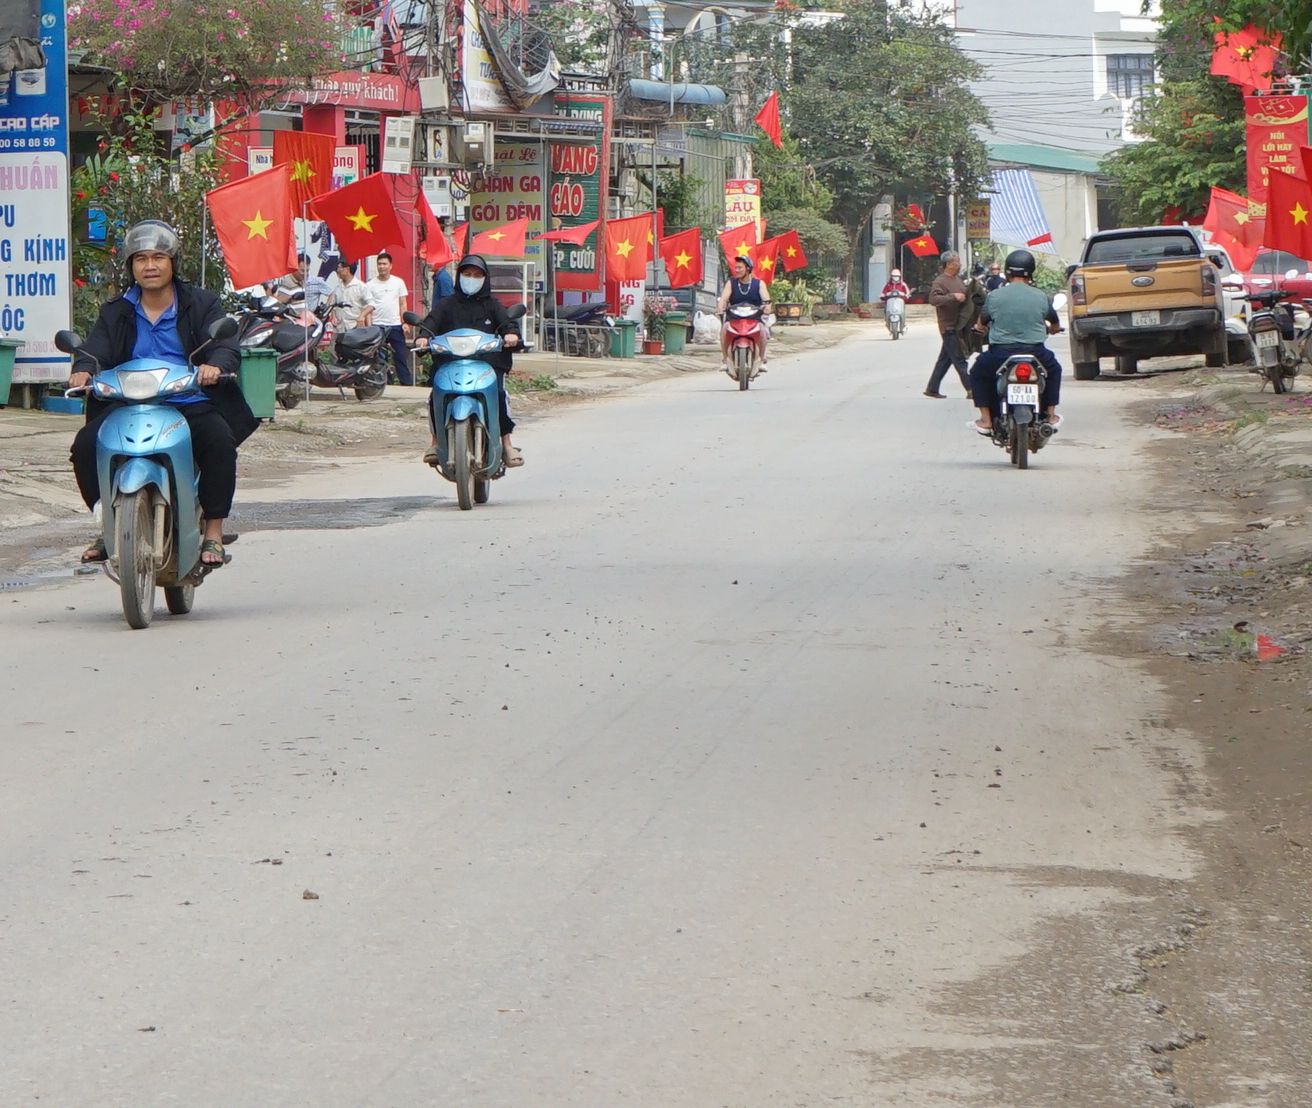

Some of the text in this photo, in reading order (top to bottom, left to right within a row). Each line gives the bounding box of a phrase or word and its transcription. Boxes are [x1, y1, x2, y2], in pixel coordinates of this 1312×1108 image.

[0, 117, 26, 130] CAO
[13, 138, 26, 147] 58
[28, 138, 40, 147] 88
[43, 137, 56, 147] 59
[0, 156, 58, 190] HUẤN
[519, 176, 541, 192] GA
[551, 177, 584, 216] CÁO
[472, 199, 500, 222] GỐI
[24, 234, 65, 261] KÍNH
[5, 271, 56, 296] THƠM
